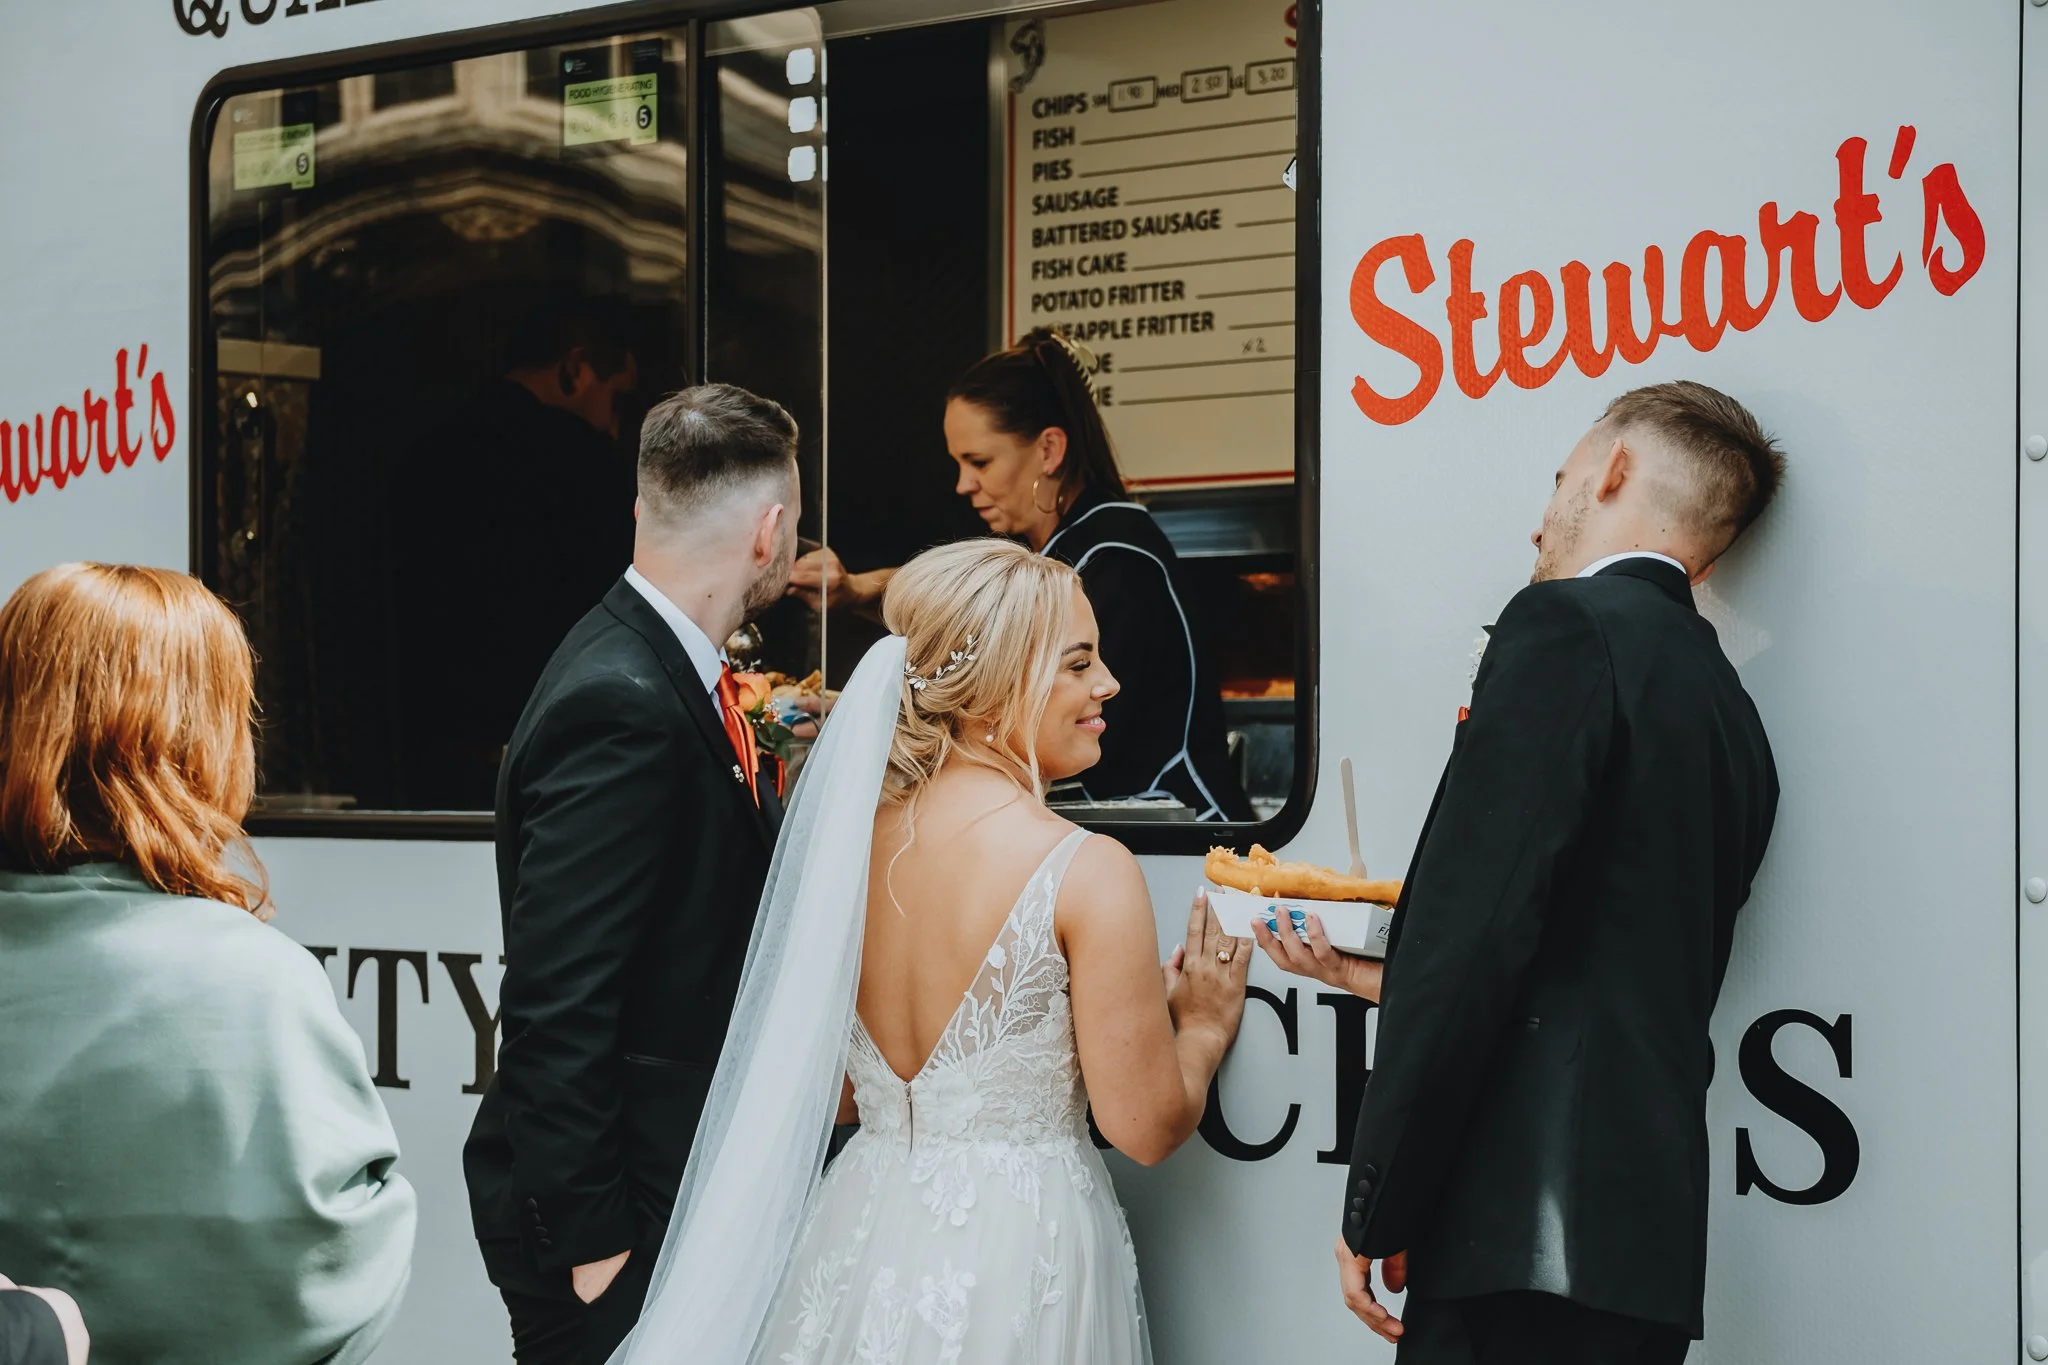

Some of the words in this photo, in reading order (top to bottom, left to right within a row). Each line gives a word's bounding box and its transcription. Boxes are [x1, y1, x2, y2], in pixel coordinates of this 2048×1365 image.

[639, 108, 649, 127] 5
[1032, 92, 1088, 119] CHIPS
[1032, 126, 1075, 150] FISH
[1032, 159, 1072, 183] PIES
[1032, 187, 1119, 216] SAUSAGE
[1032, 219, 1127, 248] BATTERED
[1131, 209, 1222, 238] SAUSAGE
[1032, 257, 1073, 281] FISH
[1077, 252, 1127, 276] CAKE
[1350, 125, 1986, 426] Stewart's
[1032, 287, 1104, 314] POTATO
[1108, 280, 1185, 306] FRITTER
[1032, 317, 1132, 341] EAPPLE
[1137, 311, 1214, 338] FRITTER
